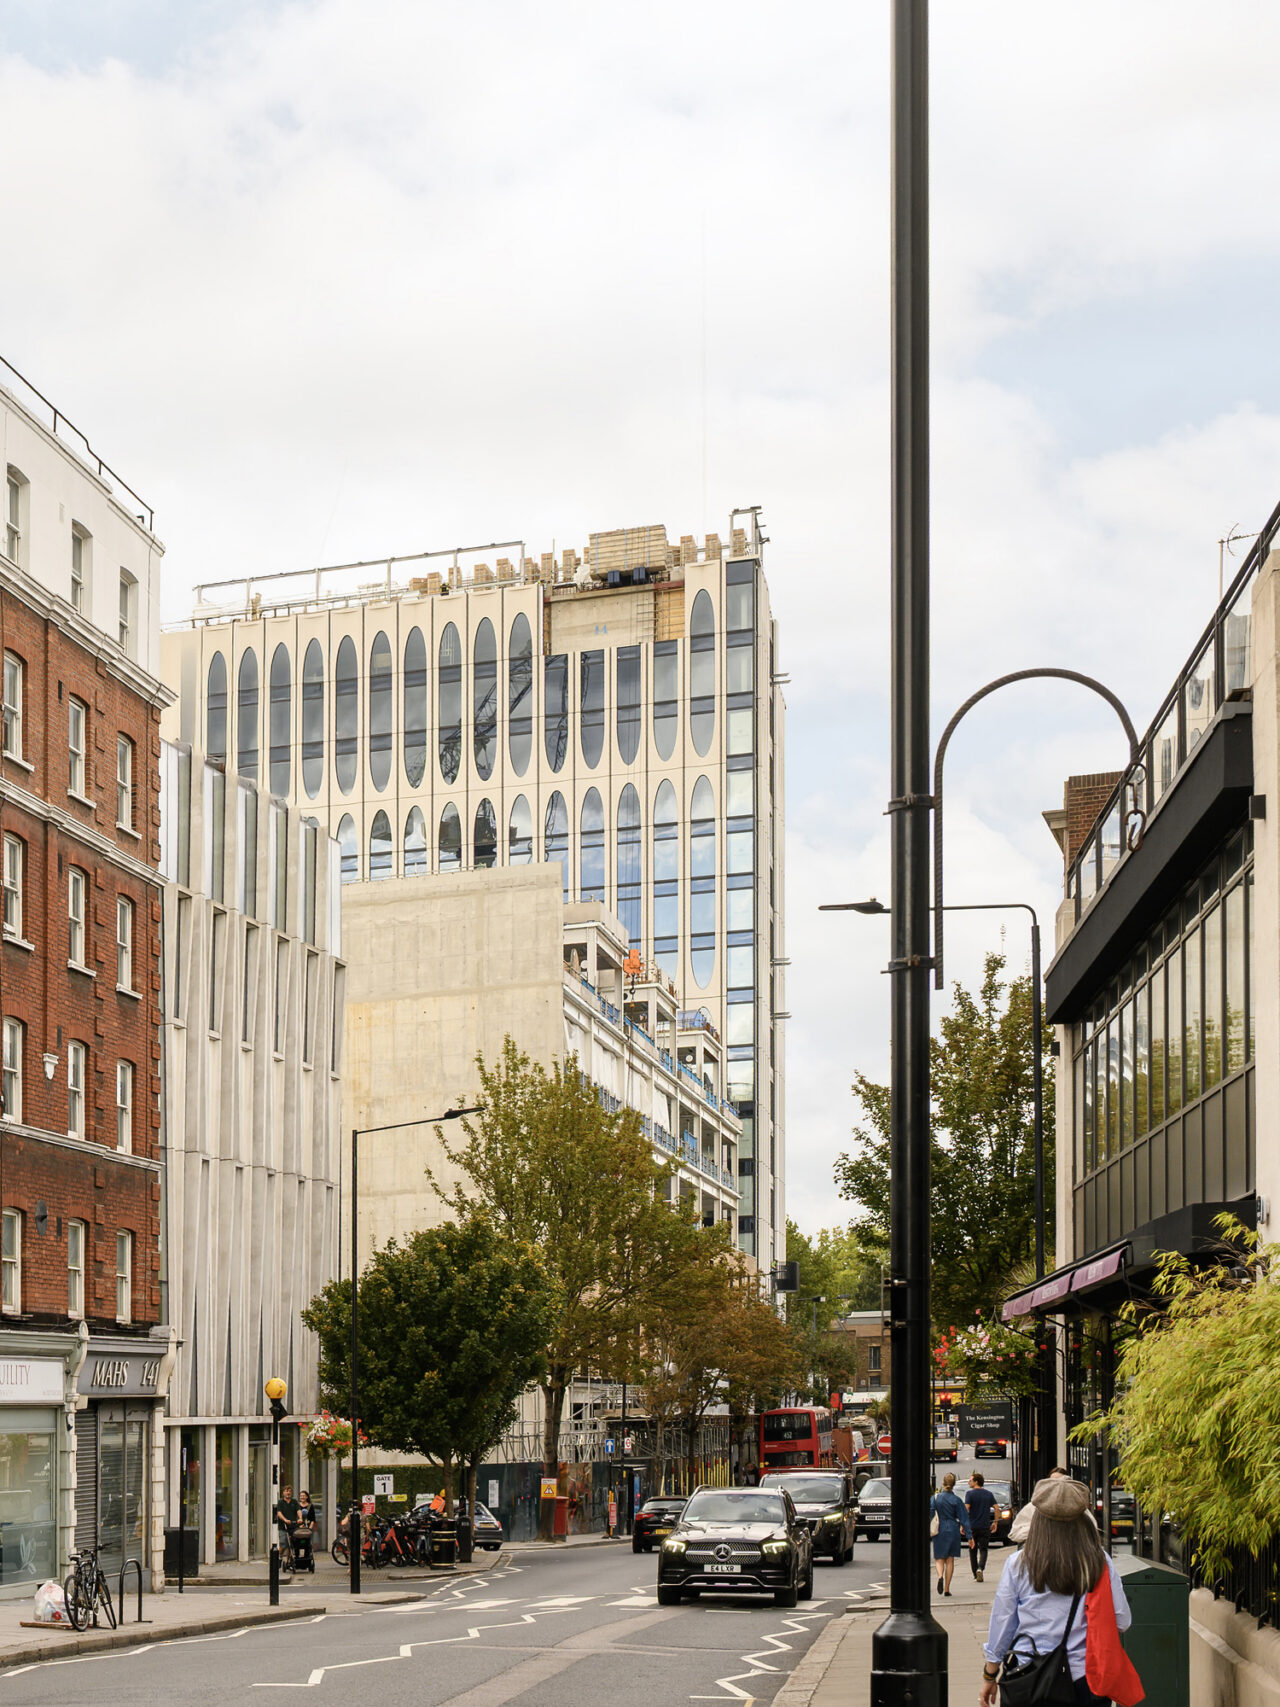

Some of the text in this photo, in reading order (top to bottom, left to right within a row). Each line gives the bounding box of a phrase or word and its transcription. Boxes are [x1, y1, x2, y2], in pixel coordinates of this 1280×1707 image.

[93, 1360, 160, 1386] MAHS 141
[381, 1482, 387, 1493] 1
